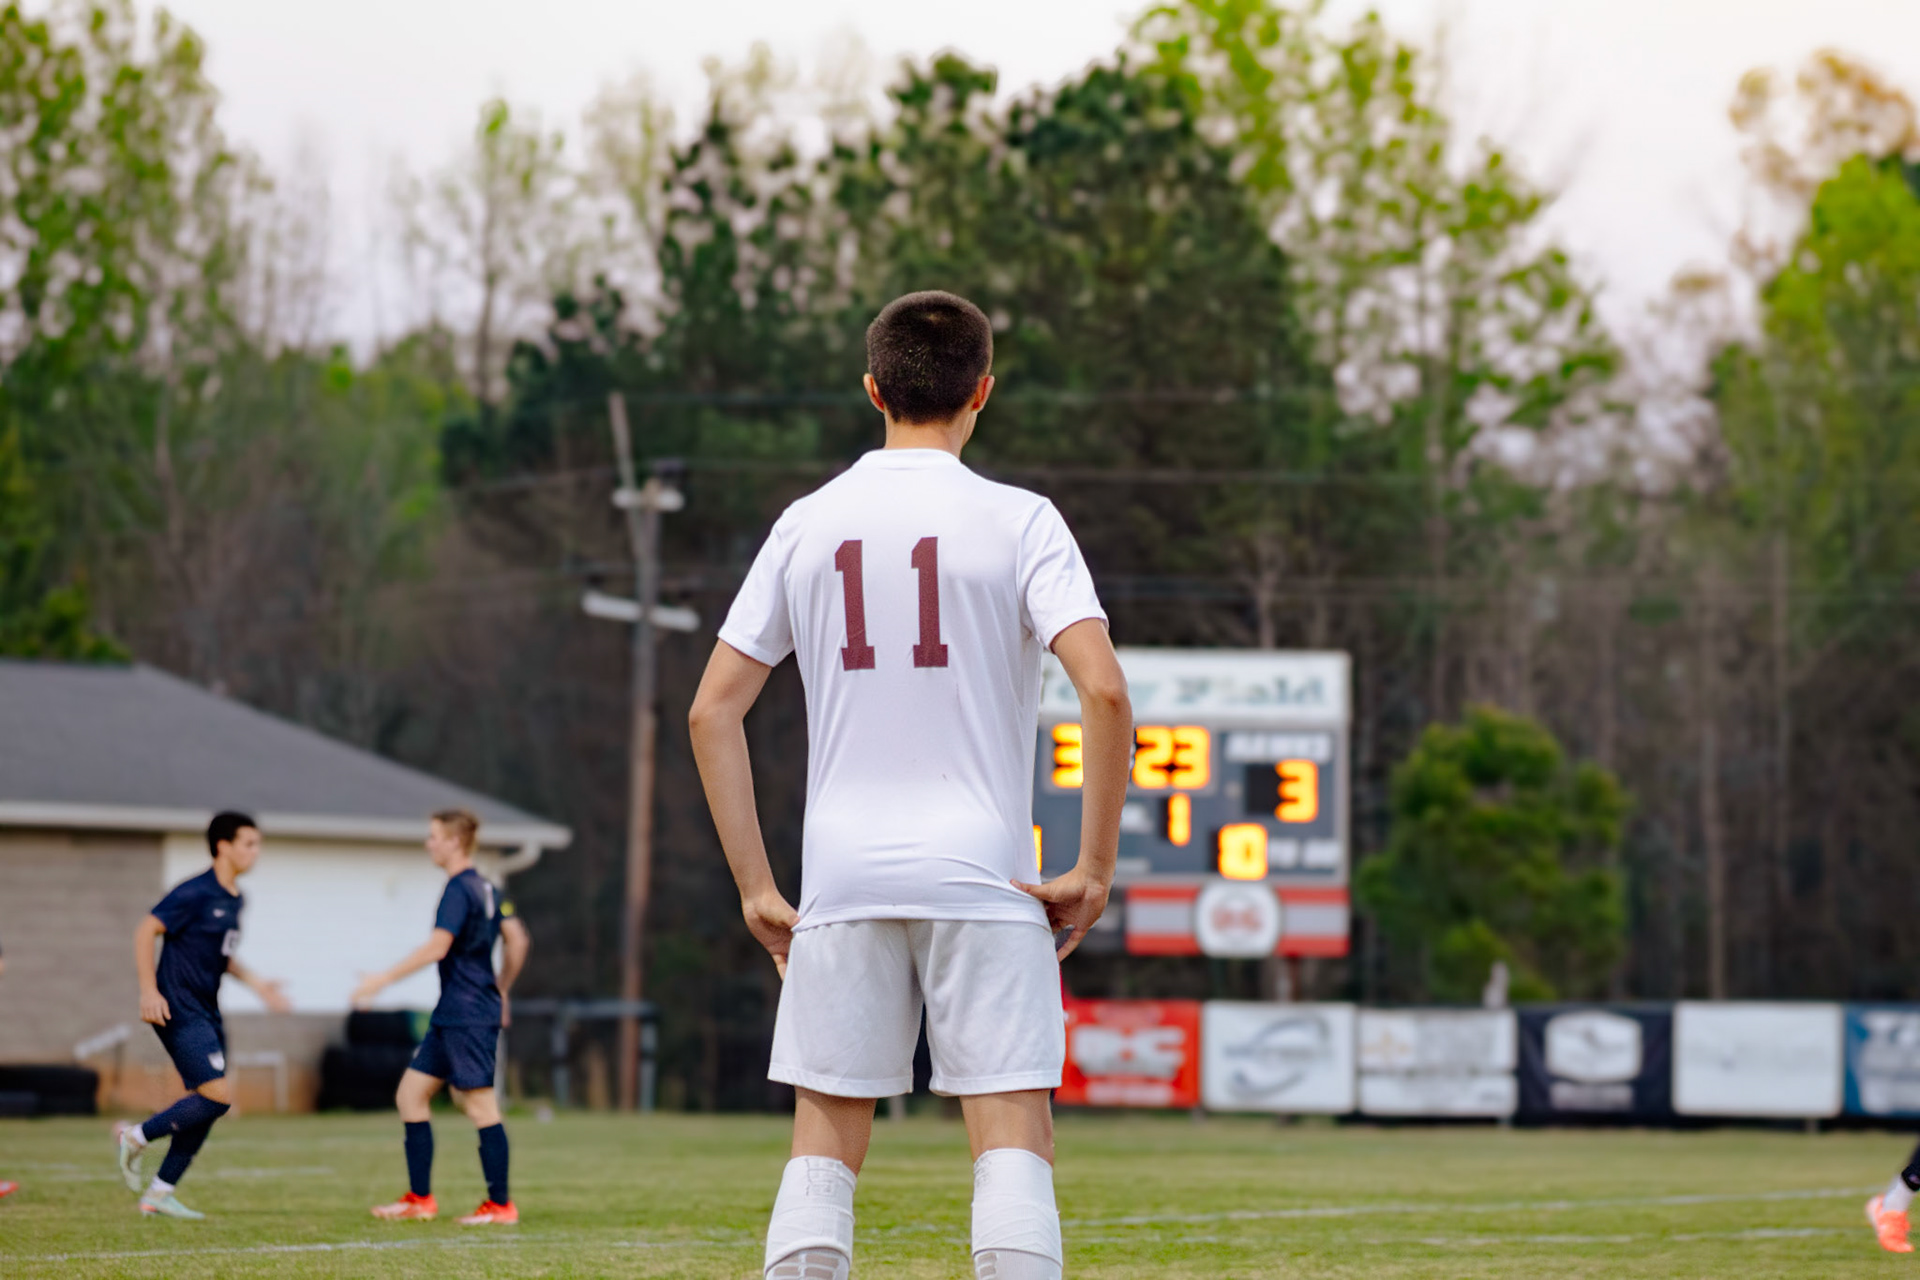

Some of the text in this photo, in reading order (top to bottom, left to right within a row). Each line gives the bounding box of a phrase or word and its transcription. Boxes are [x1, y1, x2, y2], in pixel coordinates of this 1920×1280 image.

[834, 536, 949, 672] 11
[1168, 792, 1191, 846] 1
[1275, 759, 1318, 822] 3
